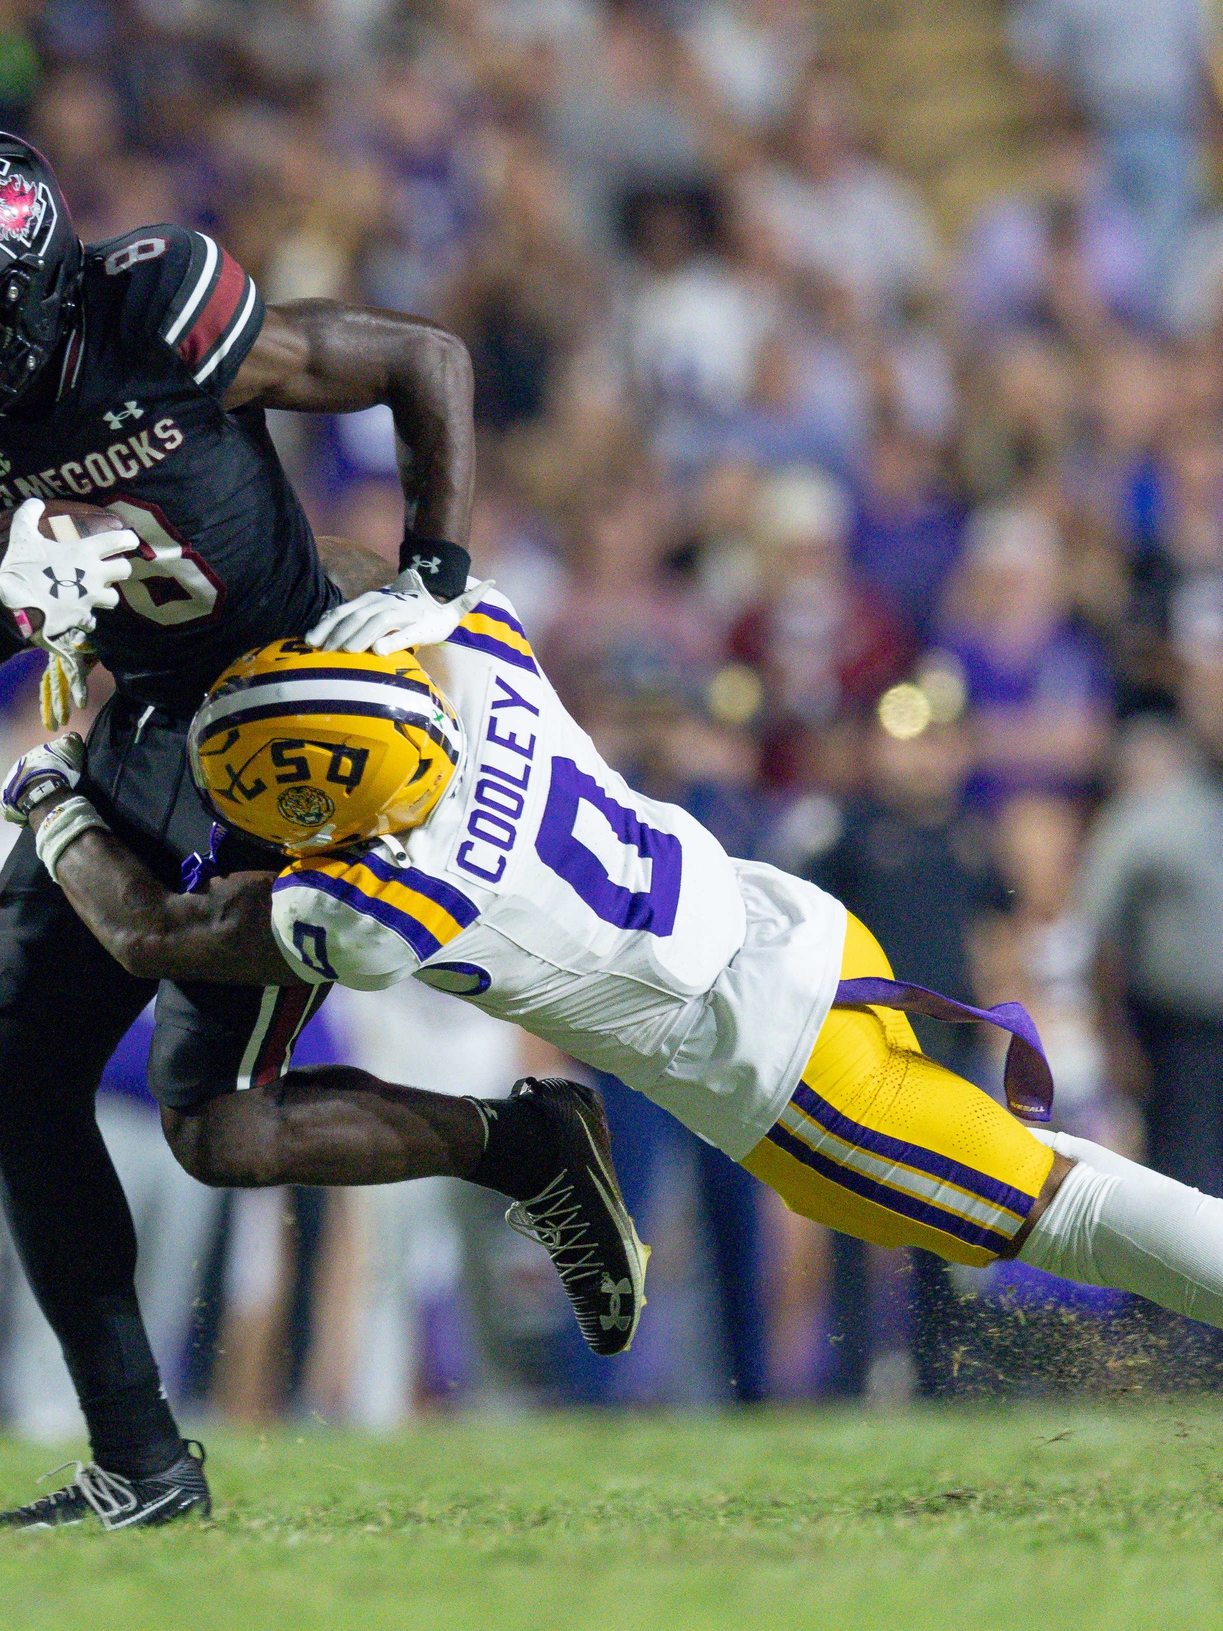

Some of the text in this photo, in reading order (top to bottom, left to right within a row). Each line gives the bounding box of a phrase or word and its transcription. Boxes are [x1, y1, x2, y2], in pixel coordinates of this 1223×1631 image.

[105, 237, 169, 275] 8
[456, 675, 539, 884] COOLEY
[534, 755, 683, 938] 0
[291, 919, 340, 981] 0
